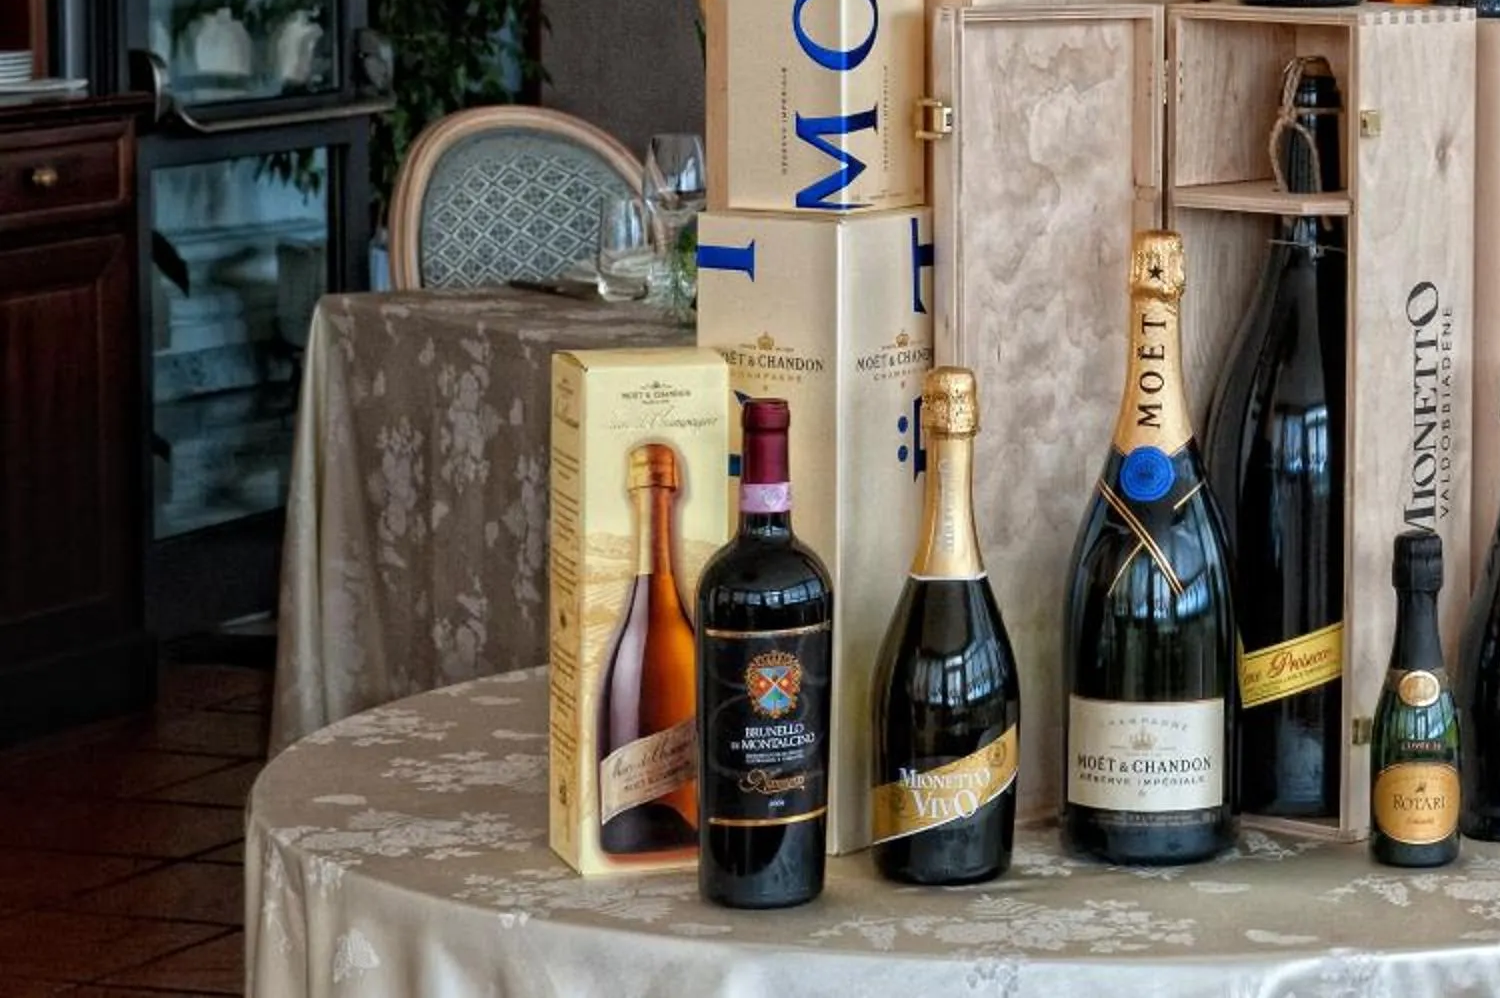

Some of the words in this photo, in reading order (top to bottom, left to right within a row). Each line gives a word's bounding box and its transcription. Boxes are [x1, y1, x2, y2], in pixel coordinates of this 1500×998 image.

[758, 353, 824, 372] CHANDON
[1136, 313, 1167, 429] MOËT
[1439, 306, 1452, 521] VALDOBBIADENE
[741, 732, 815, 750] MONTALCINO
[745, 723, 805, 738] BRUNELLO
[1077, 754, 1116, 772] MOËT
[1119, 762, 1129, 773] &
[1131, 756, 1212, 774] CHANDON
[898, 766, 991, 789] MIONETTO
[910, 788, 979, 819] VIVO
